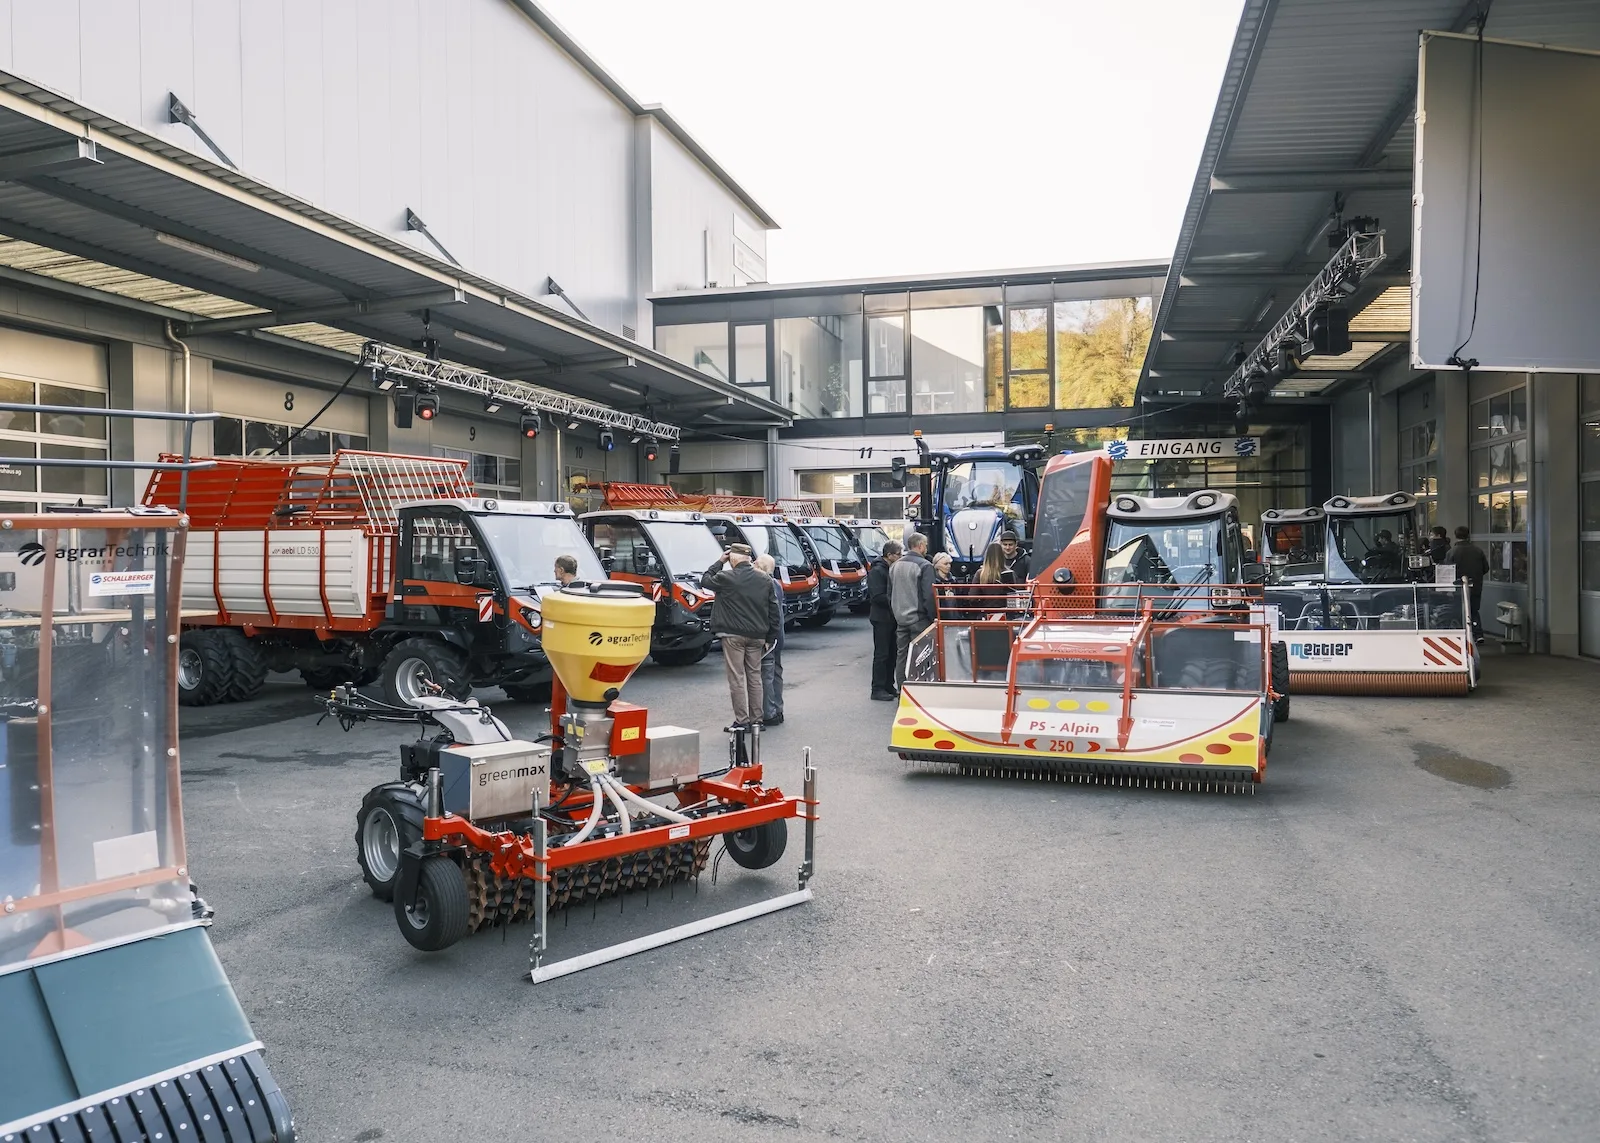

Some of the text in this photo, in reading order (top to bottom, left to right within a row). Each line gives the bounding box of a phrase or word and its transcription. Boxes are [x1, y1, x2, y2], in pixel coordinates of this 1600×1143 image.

[284, 391, 294, 411] 8
[469, 426, 476, 441] 9
[575, 445, 583, 459] 10
[859, 446, 873, 459] 11
[1140, 441, 1222, 456] EINGANG
[55, 543, 169, 562] agrarTechnik
[281, 546, 320, 555] aebi LD 530
[102, 574, 154, 583] SCHALLBERGER
[1290, 643, 1353, 659] mettler
[1029, 721, 1046, 731] PS
[1060, 722, 1100, 736] Alpin
[1050, 739, 1074, 753] 250
[479, 765, 546, 787] greenmax
